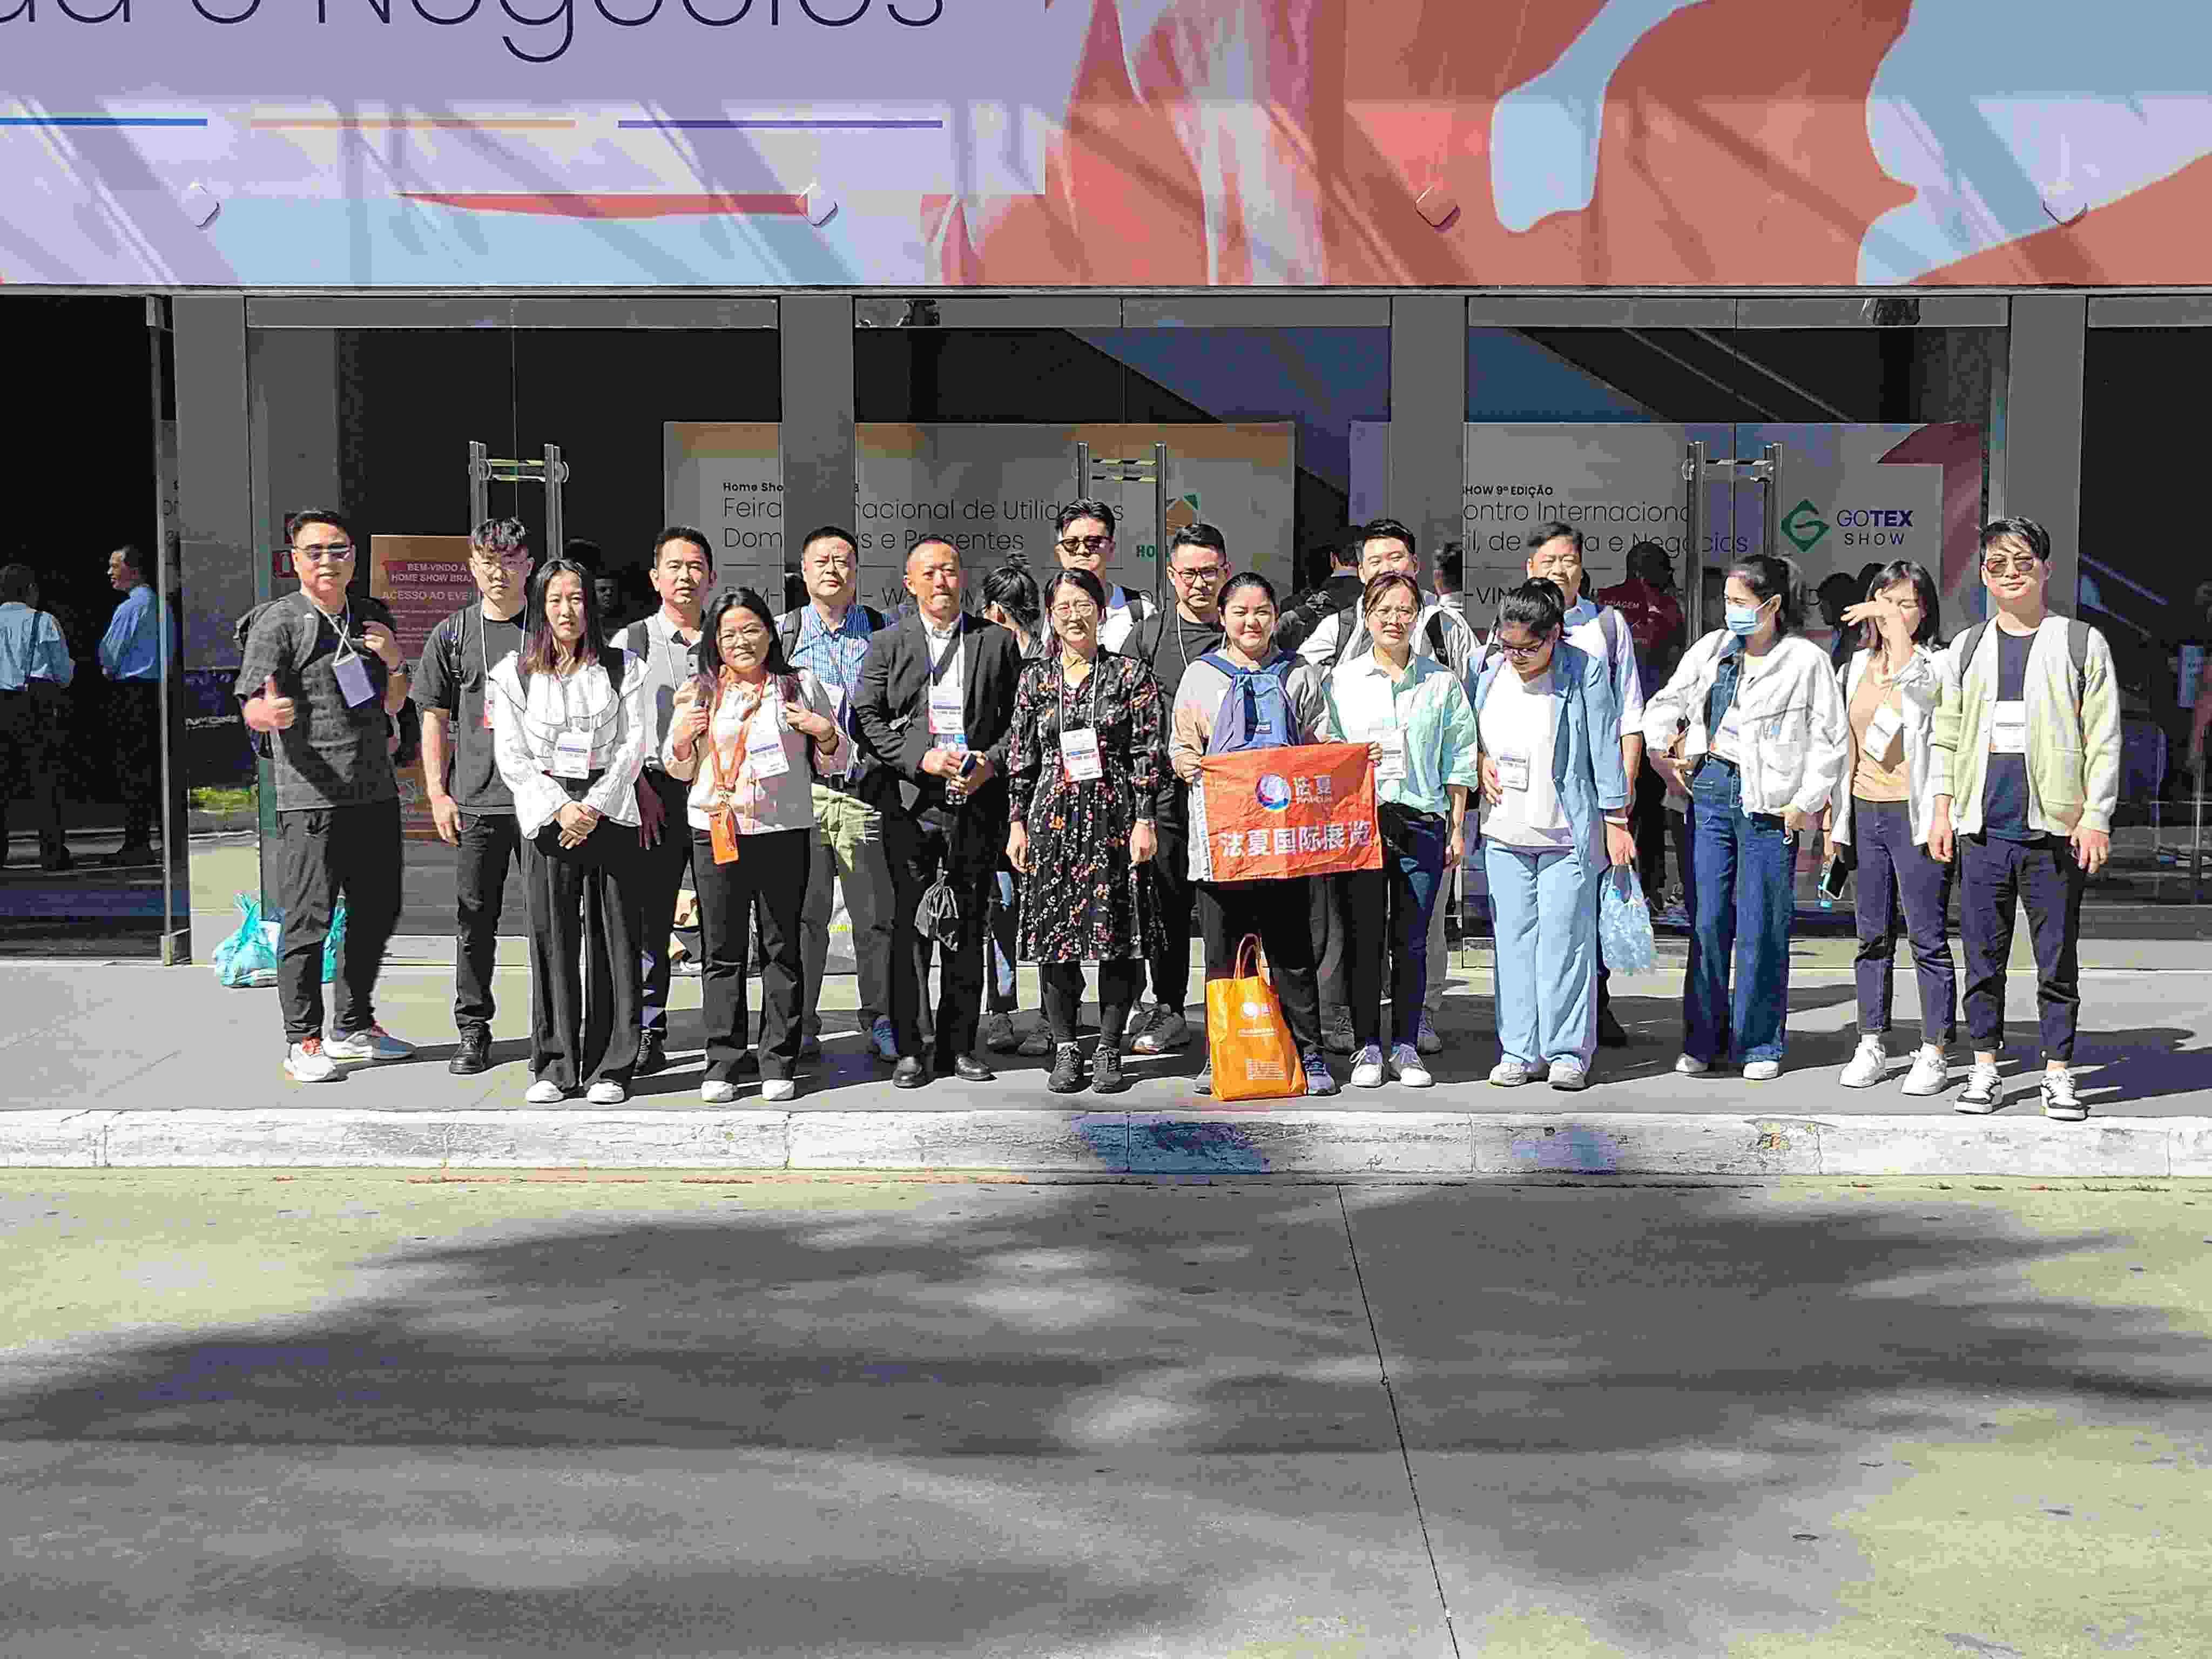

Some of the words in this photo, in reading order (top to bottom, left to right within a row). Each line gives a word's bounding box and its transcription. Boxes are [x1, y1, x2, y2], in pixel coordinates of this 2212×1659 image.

[723, 482, 757, 492] Home
[760, 482, 784, 492] Sho
[1512, 483, 1553, 498] EDIÇÃO
[724, 497, 782, 518] Feira
[963, 497, 995, 520] de
[1003, 498, 1124, 521] Utilids
[1463, 501, 1529, 521] ontro
[1837, 509, 1914, 527] GOTEX
[881, 532, 896, 550] e
[1489, 531, 1521, 551] de
[1608, 536, 1623, 552] e
[1844, 532, 1905, 545] SHOW
[420, 574, 448, 583] SHOW
[429, 591, 446, 601] AO
